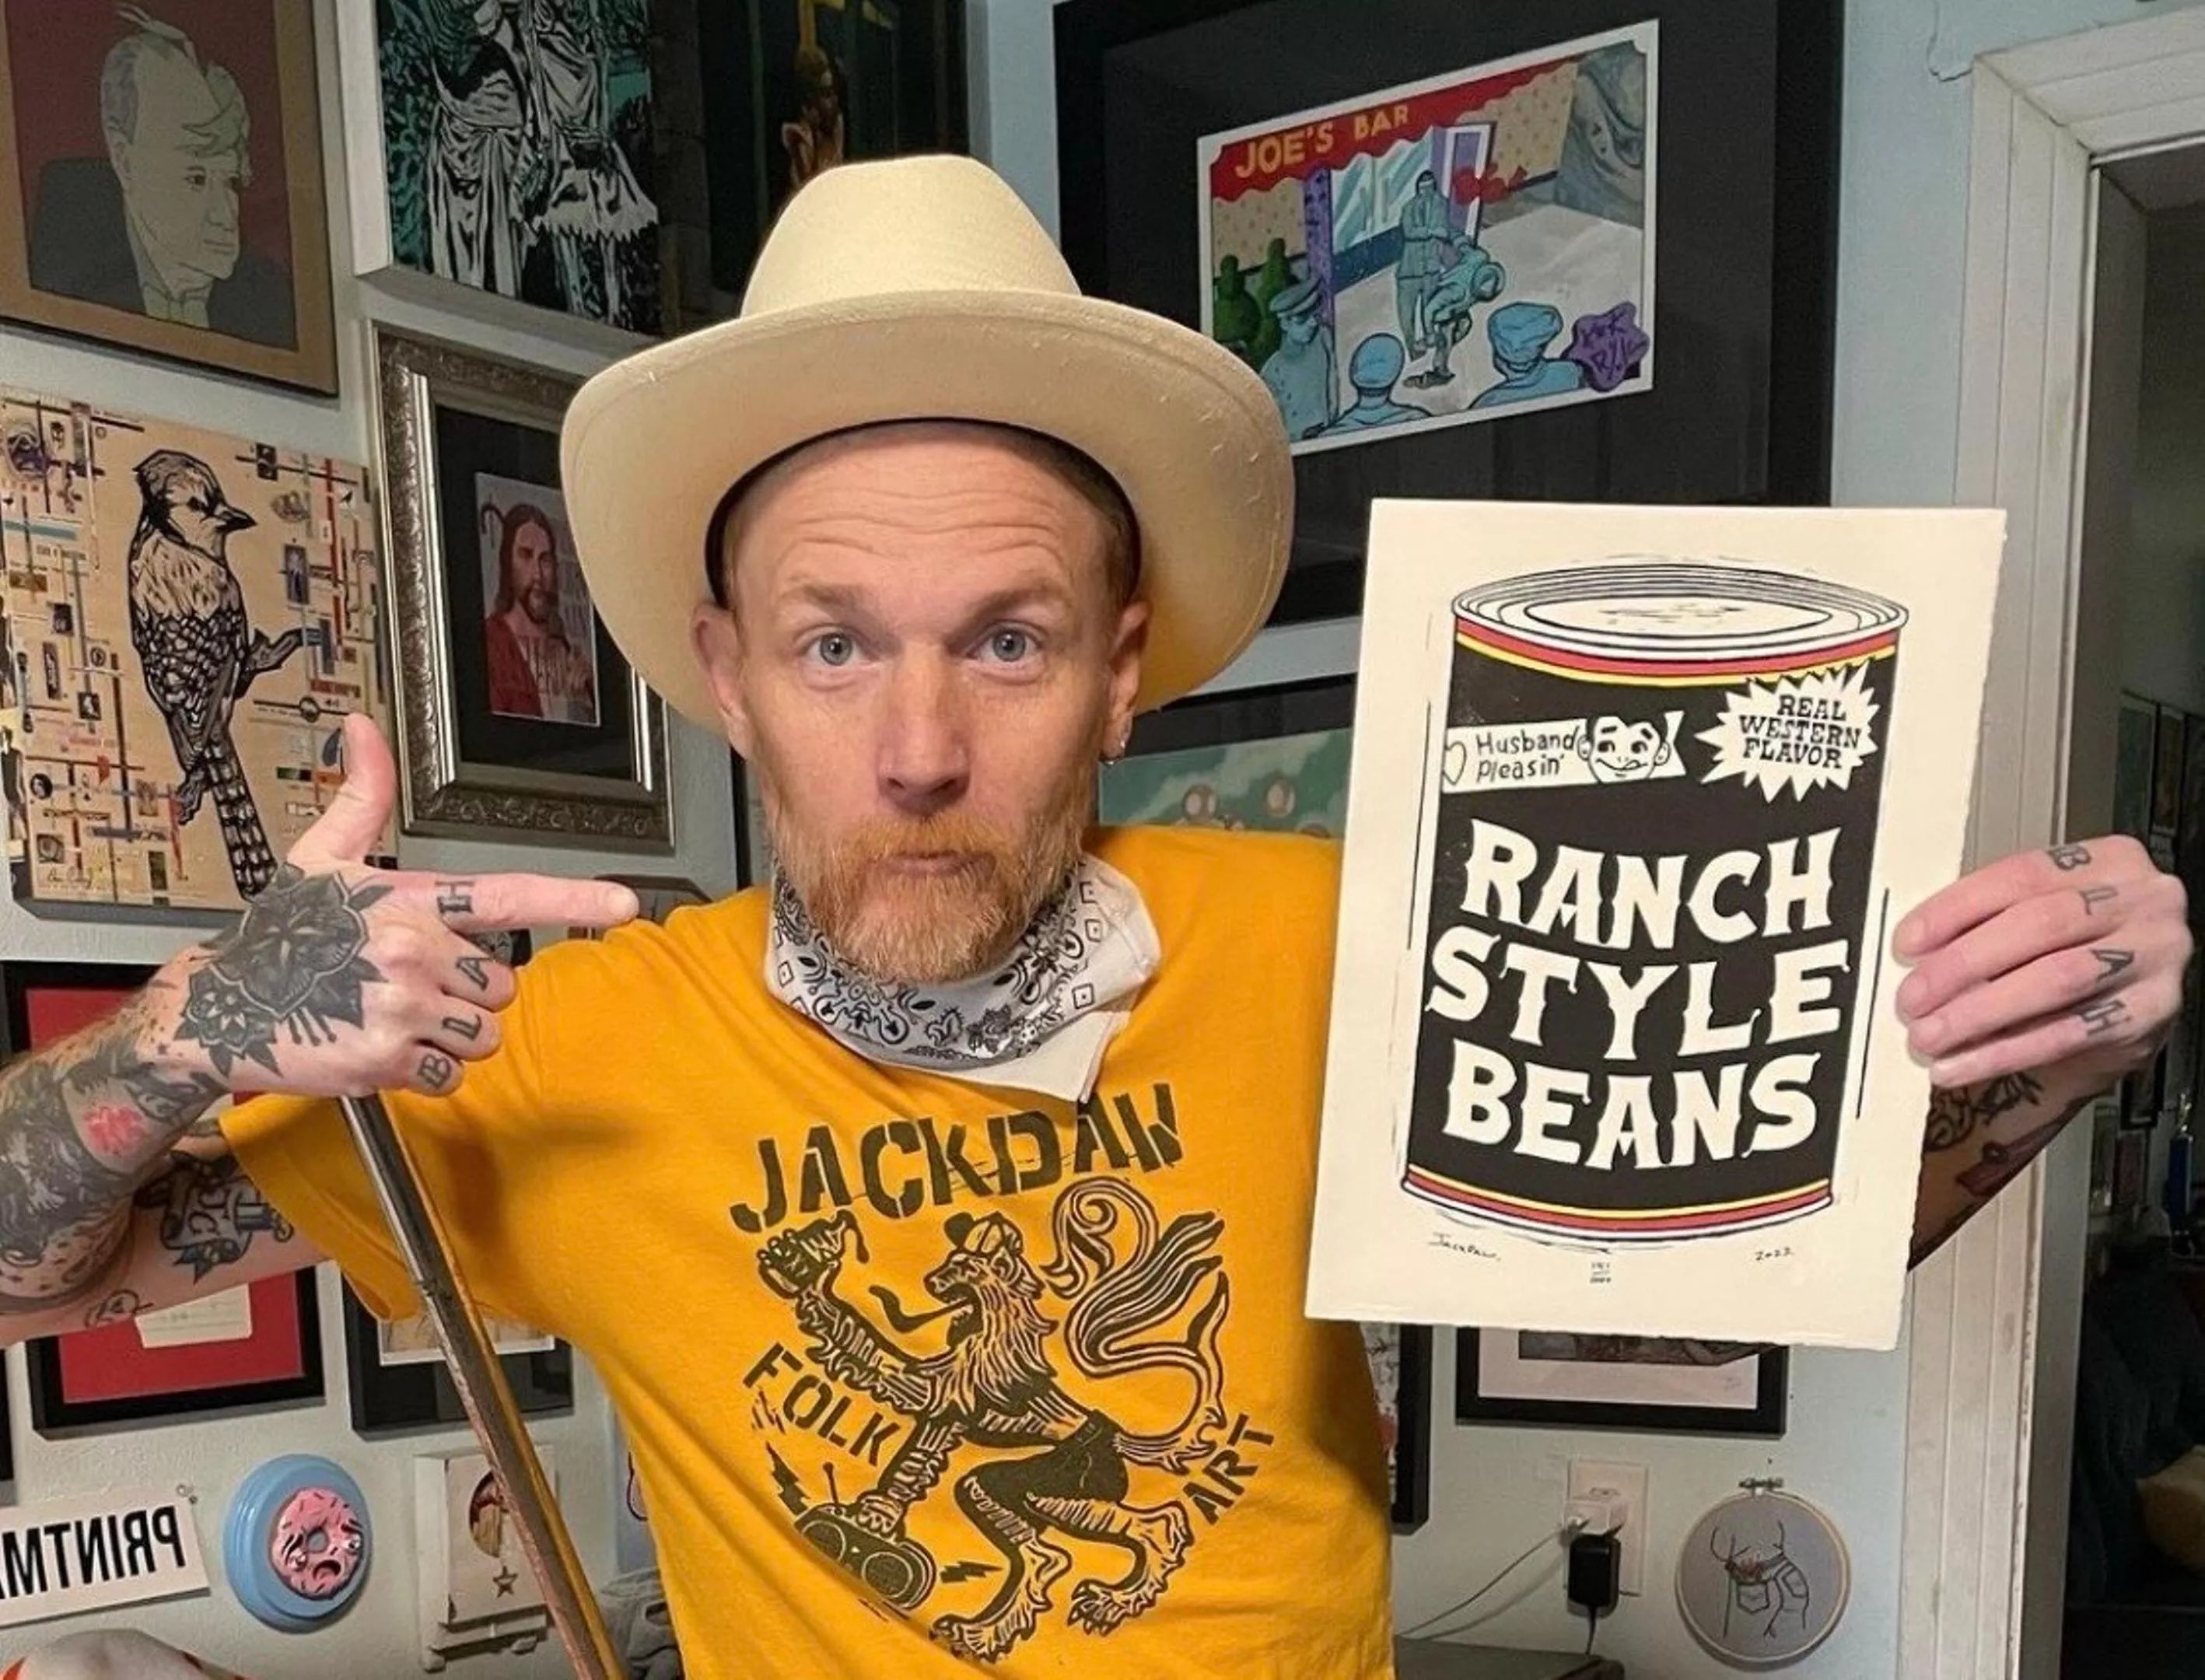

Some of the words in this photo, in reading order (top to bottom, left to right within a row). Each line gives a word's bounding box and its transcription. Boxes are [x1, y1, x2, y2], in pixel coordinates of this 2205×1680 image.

[1235, 121, 1334, 178] JOE'S
[1353, 104, 1409, 142] BAR
[1475, 725, 1580, 754] Husband
[1739, 715, 1861, 749] WESTERN
[1743, 737, 1843, 769] FLAVOR
[1776, 694, 1846, 721] REAL
[1461, 819, 1841, 950] RANCH
[1426, 926, 1850, 1060] STYLE
[730, 1083, 1183, 1231] JACKDAW
[1443, 1038, 1821, 1170] BEANS
[743, 1342, 900, 1467] FOLK
[1183, 1412, 1275, 1525] ART
